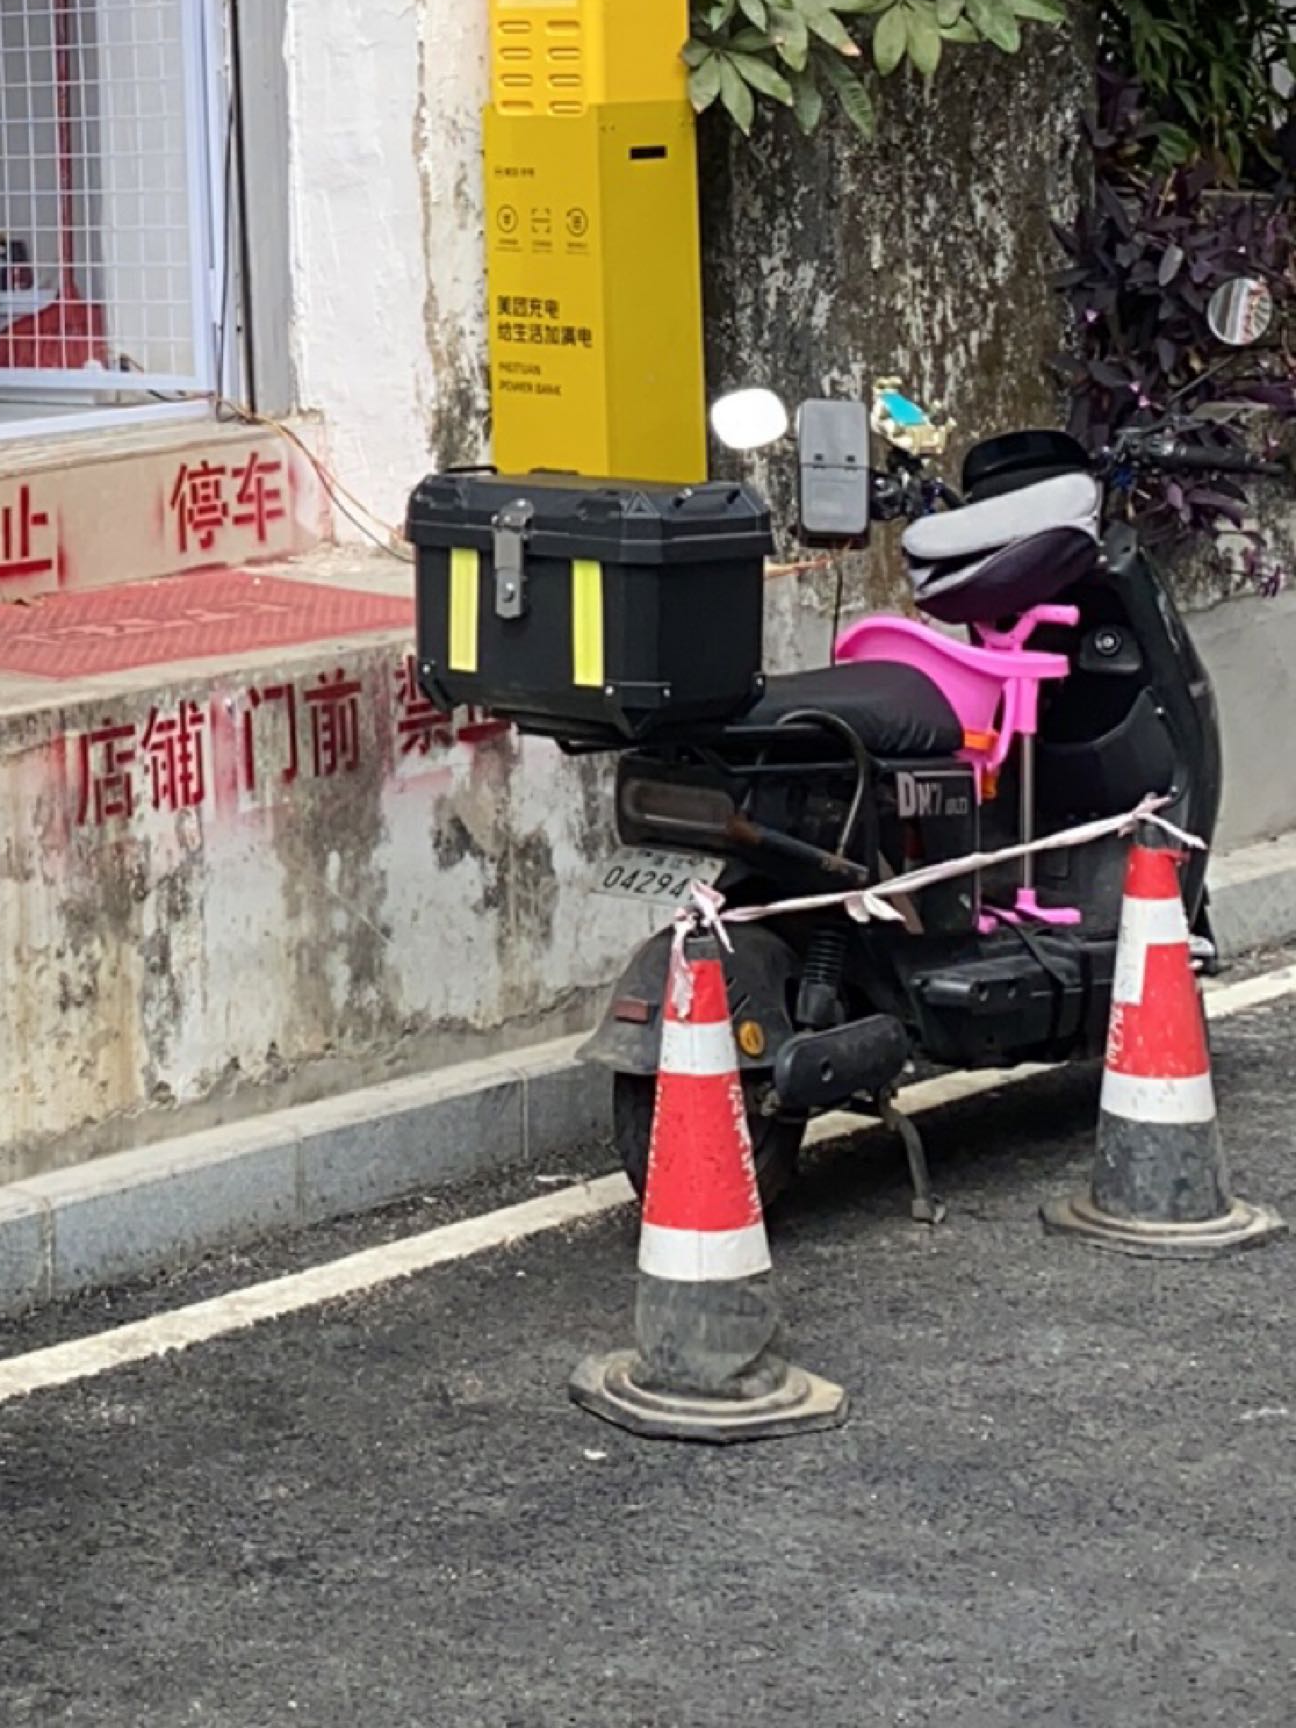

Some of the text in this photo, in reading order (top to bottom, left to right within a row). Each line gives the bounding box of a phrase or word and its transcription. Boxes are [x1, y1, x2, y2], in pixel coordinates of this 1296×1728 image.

[169, 451, 286, 553] 停车
[77, 698, 204, 826] 店铺
[242, 668, 361, 791] 门前
[603, 864, 709, 902] 04294
